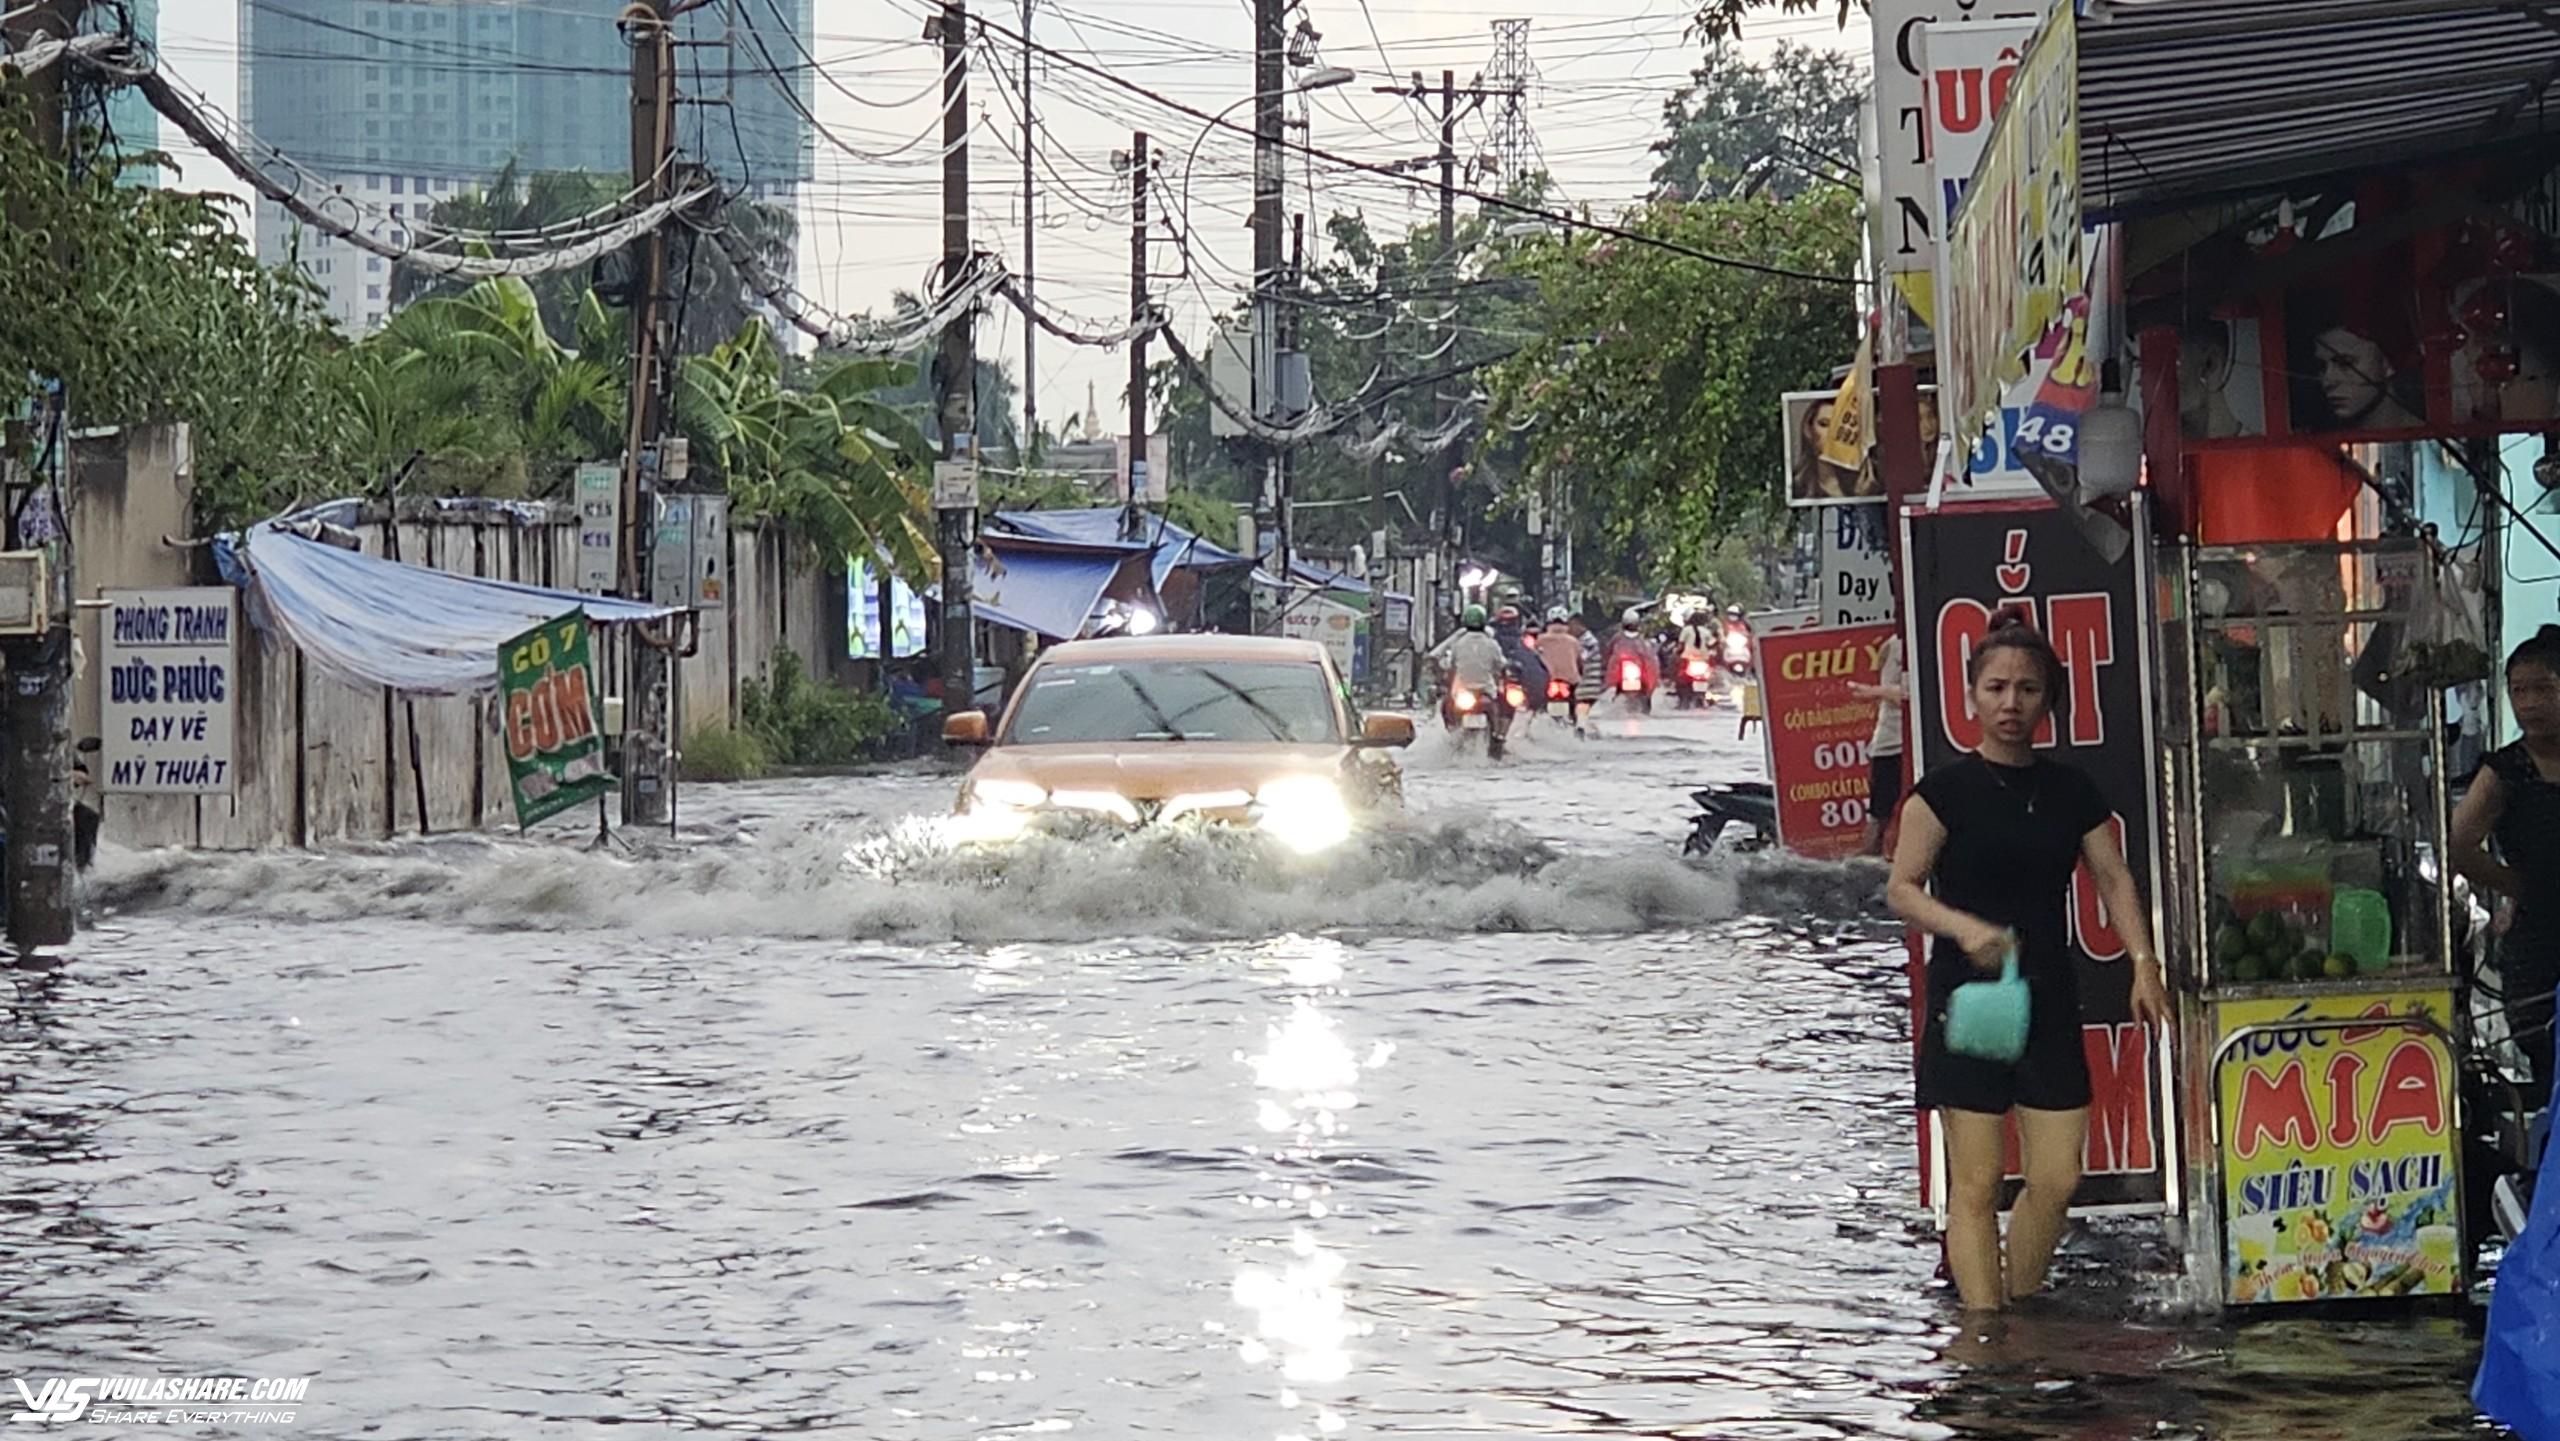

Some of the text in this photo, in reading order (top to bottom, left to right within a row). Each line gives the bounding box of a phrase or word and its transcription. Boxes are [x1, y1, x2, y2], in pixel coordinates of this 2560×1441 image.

[1838, 571, 1880, 603] Dạy
[113, 596, 229, 642] PHÒNG TRANH
[559, 621, 578, 653] 7
[1781, 639, 1857, 681] CHÚ
[131, 710, 209, 747] DẠY VẼ
[507, 661, 600, 762] CƠM
[111, 753, 228, 790] MỸ THUẬT
[1821, 798, 1870, 828] 80
[2233, 1002, 2446, 1161] MÍA
[2238, 1153, 2443, 1218] SIÊU SẠCH
